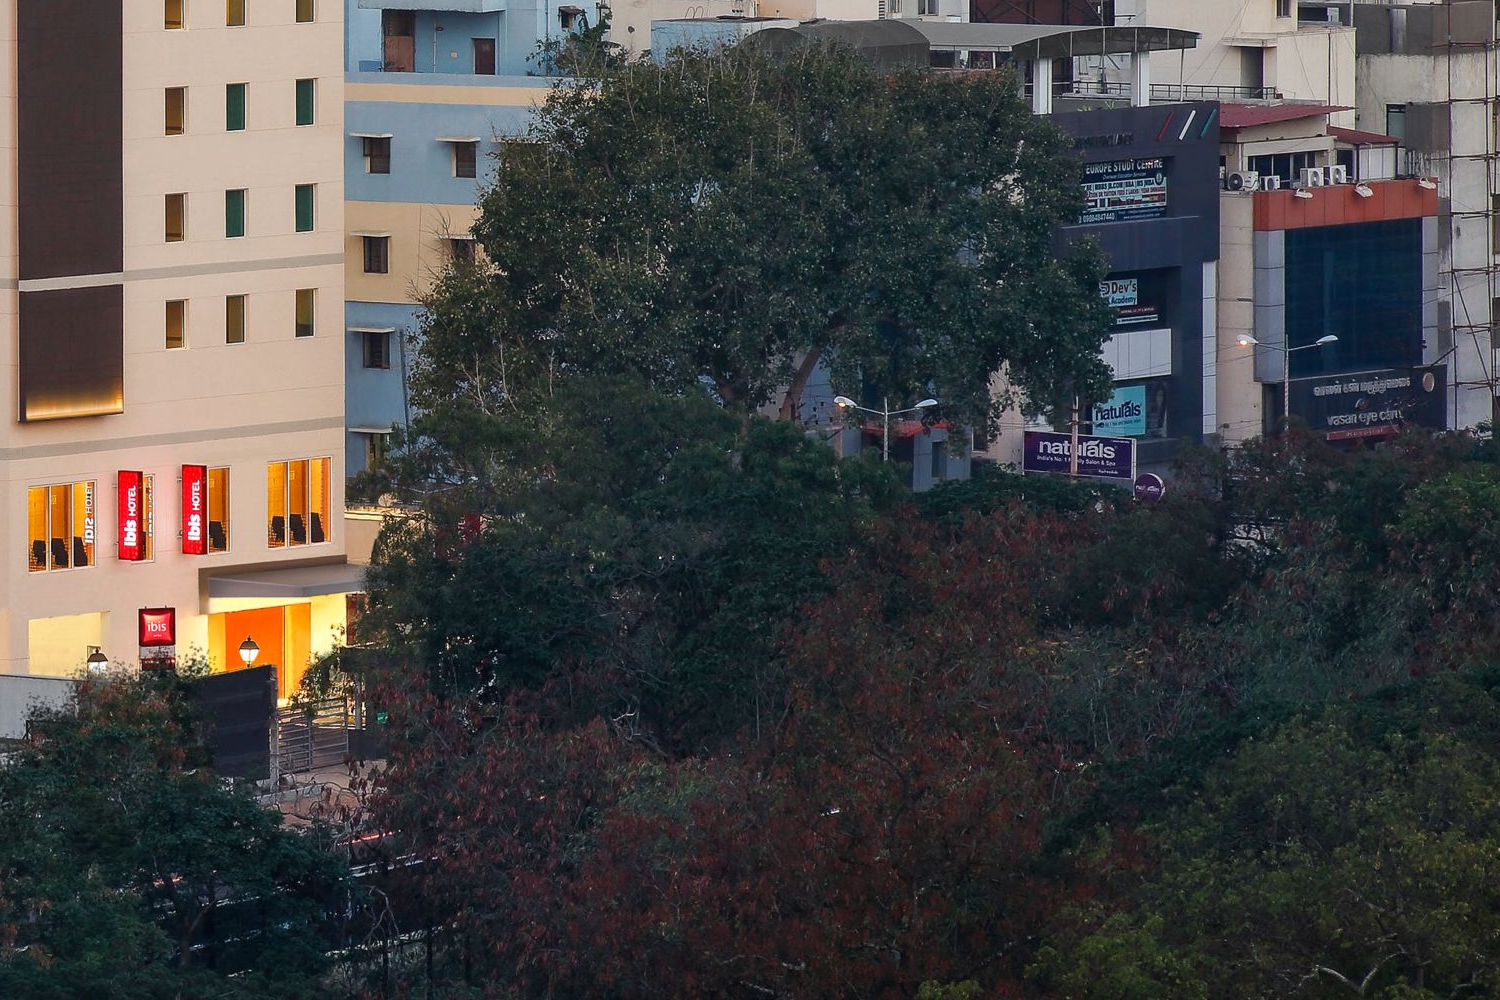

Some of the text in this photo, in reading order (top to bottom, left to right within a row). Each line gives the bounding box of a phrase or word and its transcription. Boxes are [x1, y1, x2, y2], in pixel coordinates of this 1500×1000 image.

[1086, 162, 1112, 174] EUROPE
[1113, 160, 1135, 172] STUDY
[1112, 280, 1137, 294] Dev's
[1095, 400, 1141, 421] naturals
[1327, 413, 1357, 426] vasan
[1359, 411, 1378, 426] eye
[123, 485, 137, 547] ibis HOTEL
[187, 480, 201, 541] ibis HOTEL
[147, 621, 167, 632] ibis
